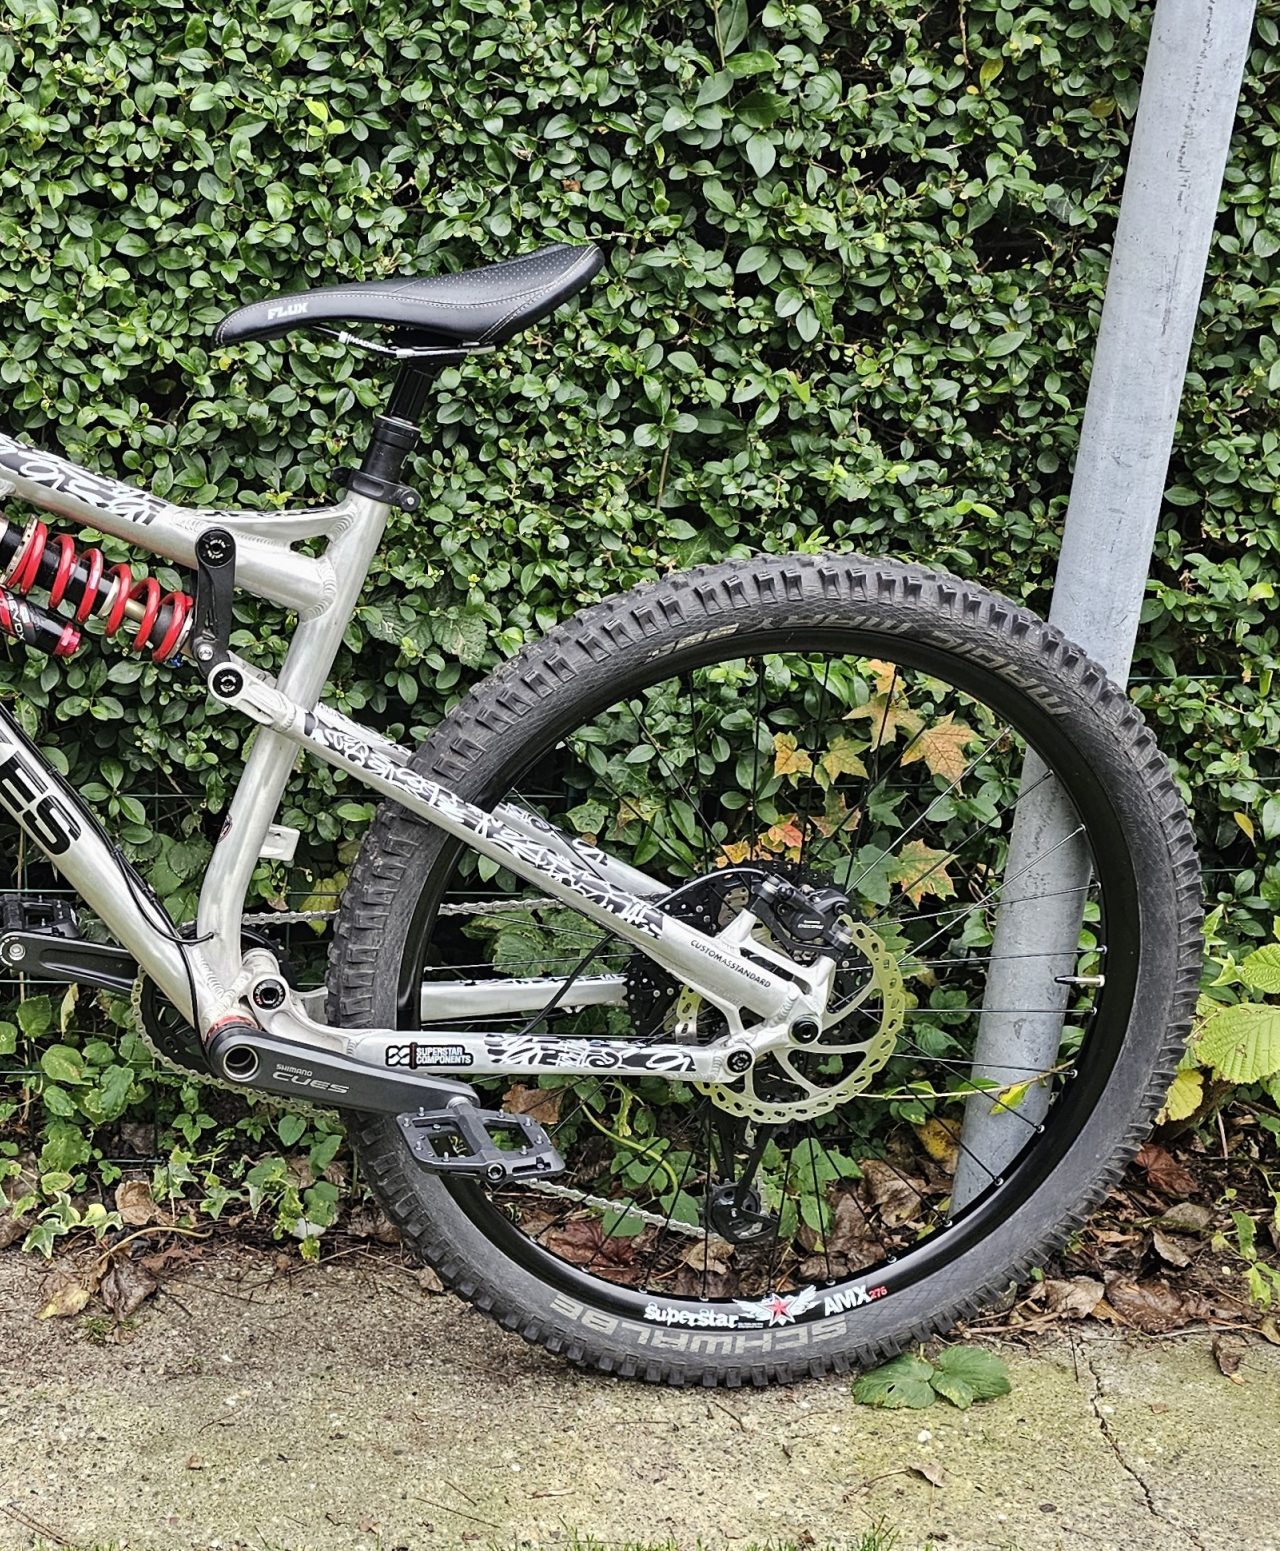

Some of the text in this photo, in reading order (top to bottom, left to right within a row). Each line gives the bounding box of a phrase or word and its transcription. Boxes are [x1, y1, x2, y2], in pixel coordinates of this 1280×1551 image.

[268, 302, 309, 320] FLUX
[416, 1047, 463, 1056] SUPERSTAR
[416, 1056, 471, 1064] COMPONENTS
[276, 1064, 313, 1077] SHIMANO
[273, 1071, 349, 1094] CUES
[550, 1294, 847, 1354] SCHWALBE
